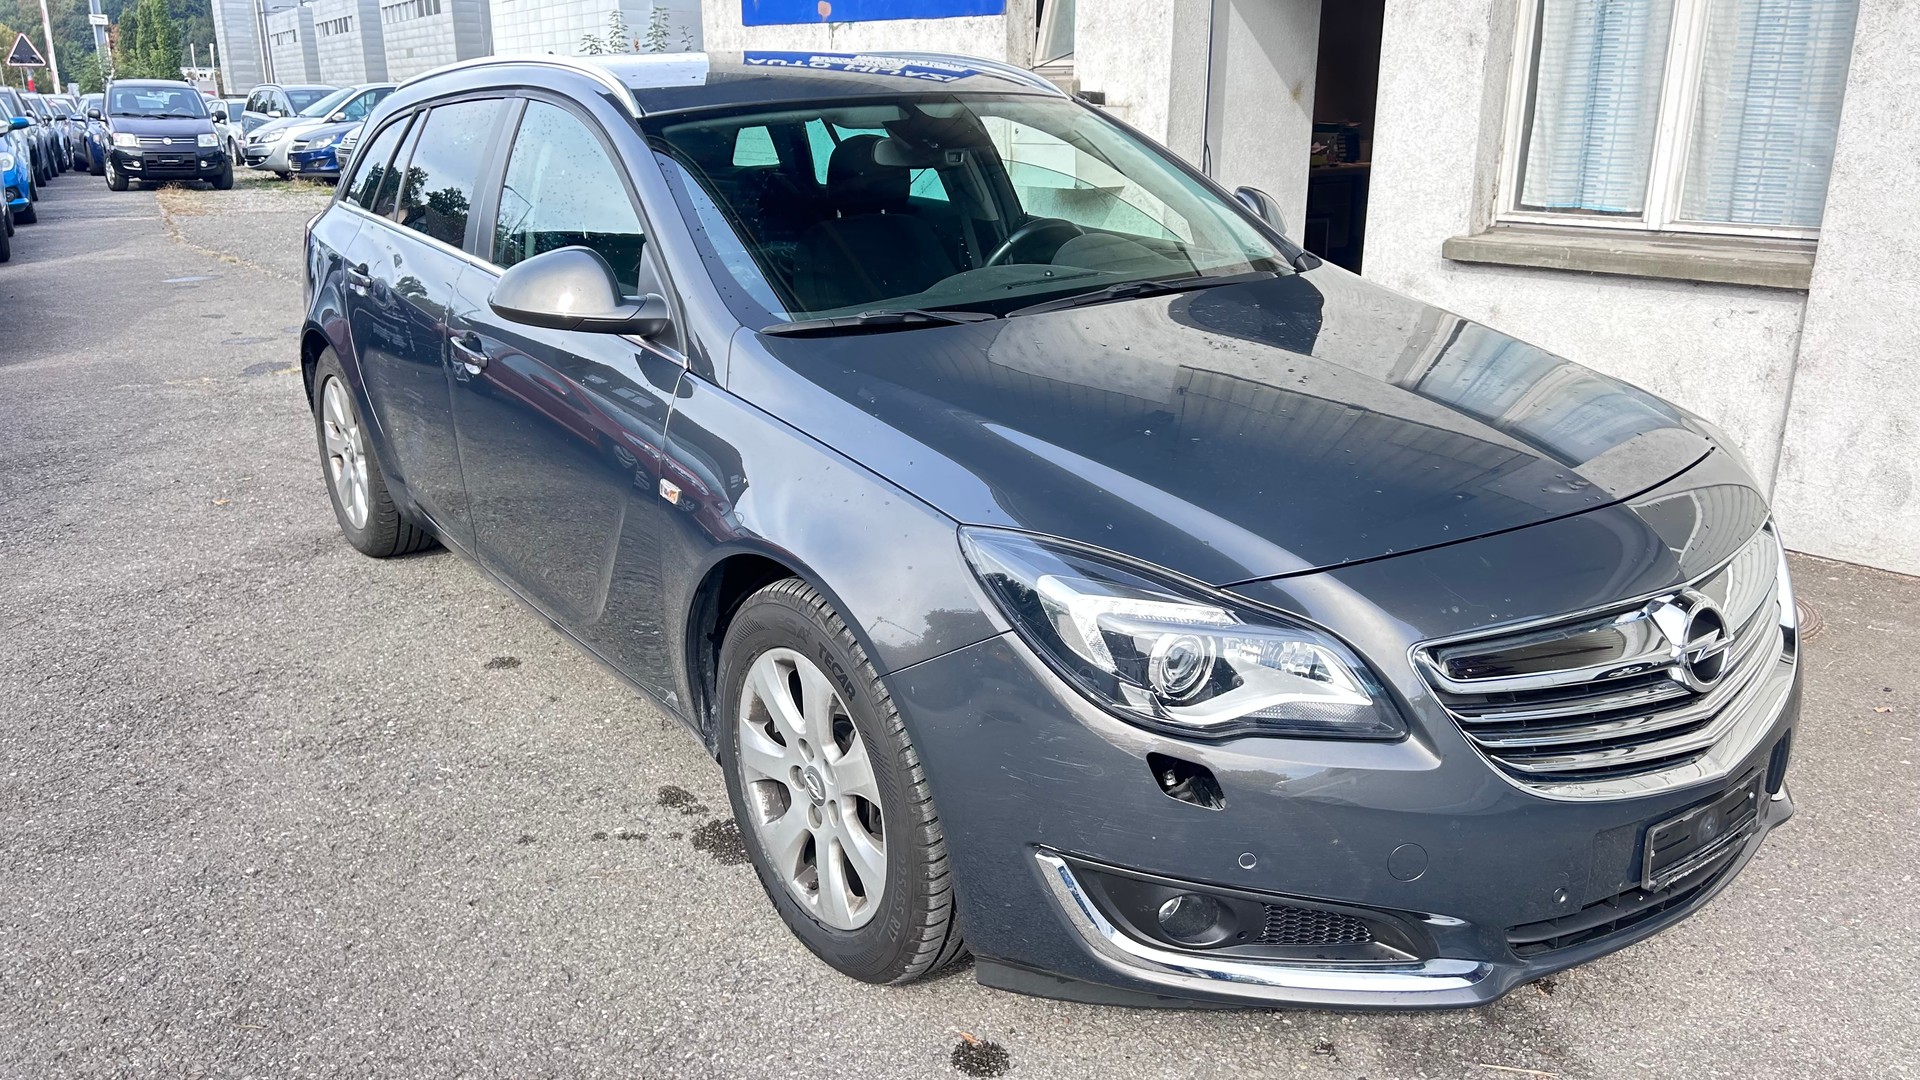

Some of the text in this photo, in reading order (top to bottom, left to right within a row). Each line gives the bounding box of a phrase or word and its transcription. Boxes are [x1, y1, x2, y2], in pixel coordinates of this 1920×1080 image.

[818, 642, 857, 702] TECAR
[887, 852, 907, 943] 225/55 R17
